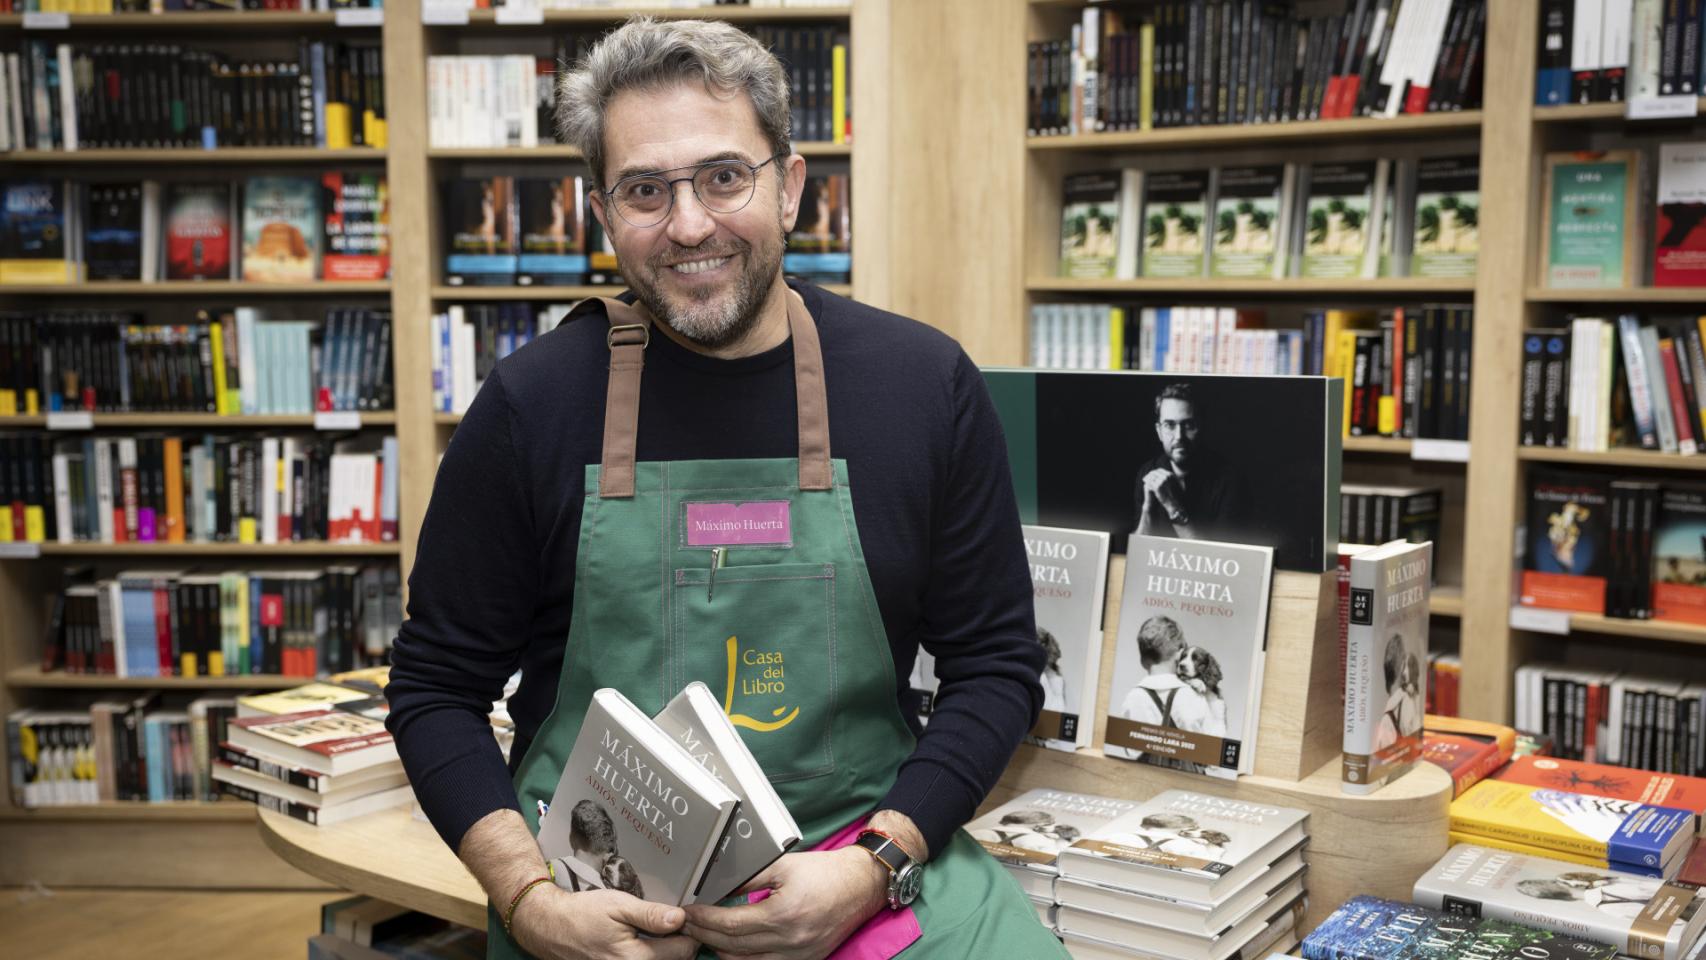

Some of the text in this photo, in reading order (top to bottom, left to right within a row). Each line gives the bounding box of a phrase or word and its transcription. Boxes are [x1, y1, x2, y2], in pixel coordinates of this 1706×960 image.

[695, 519, 783, 532] Máximo Huerta
[1024, 538, 1077, 560] XIMO
[1147, 547, 1240, 577] MÁXIMO
[1029, 563, 1071, 585] RTA
[1386, 559, 1426, 588] MÁXIMO
[1034, 586, 1072, 598] QUEÑO
[1146, 575, 1233, 603] HUERTA
[1387, 585, 1424, 613] HUERTA
[1180, 602, 1234, 618] PEQUEÑO
[743, 649, 783, 665] Casa
[763, 666, 784, 679] del
[743, 679, 785, 695] Libro
[1163, 738, 1180, 747] LARA
[600, 728, 689, 817] MÁXIMO
[680, 727, 753, 840] MÁXO
[593, 757, 675, 841] HUERTA
[585, 775, 618, 809] ADIÓS,
[620, 806, 672, 856] PEQUEÑO
[1437, 847, 1485, 882] MÁXIMO
[1466, 853, 1512, 887] HUERTA
